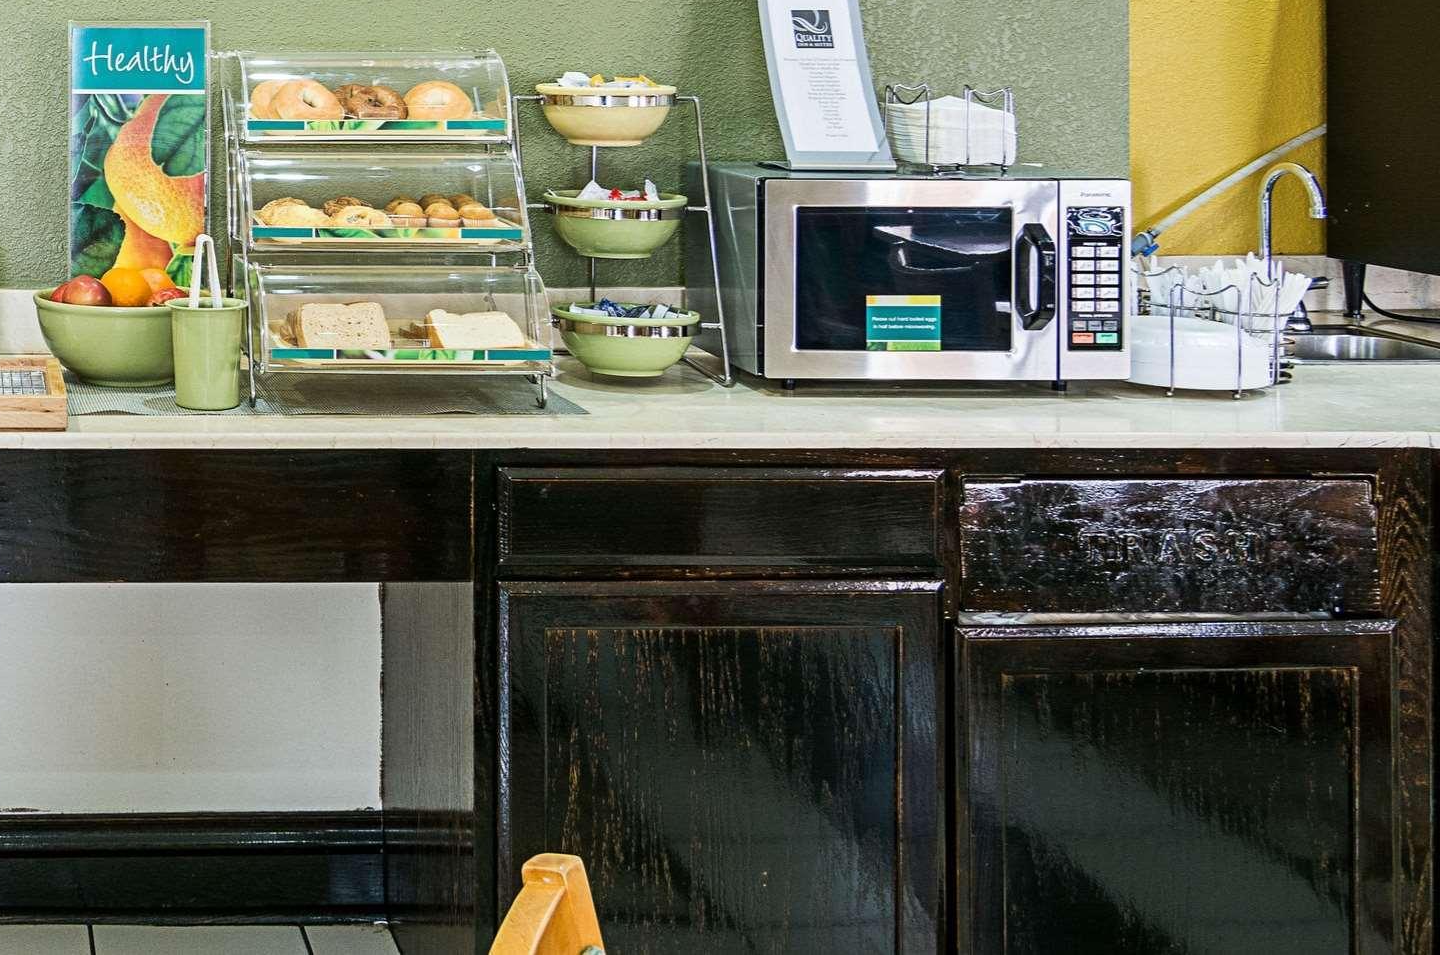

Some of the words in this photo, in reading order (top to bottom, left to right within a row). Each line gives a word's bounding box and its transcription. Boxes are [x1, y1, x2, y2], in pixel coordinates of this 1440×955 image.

[795, 32, 833, 43] QUALITY
[82, 40, 195, 84] Healthy
[1078, 528, 1262, 566] TRASH
